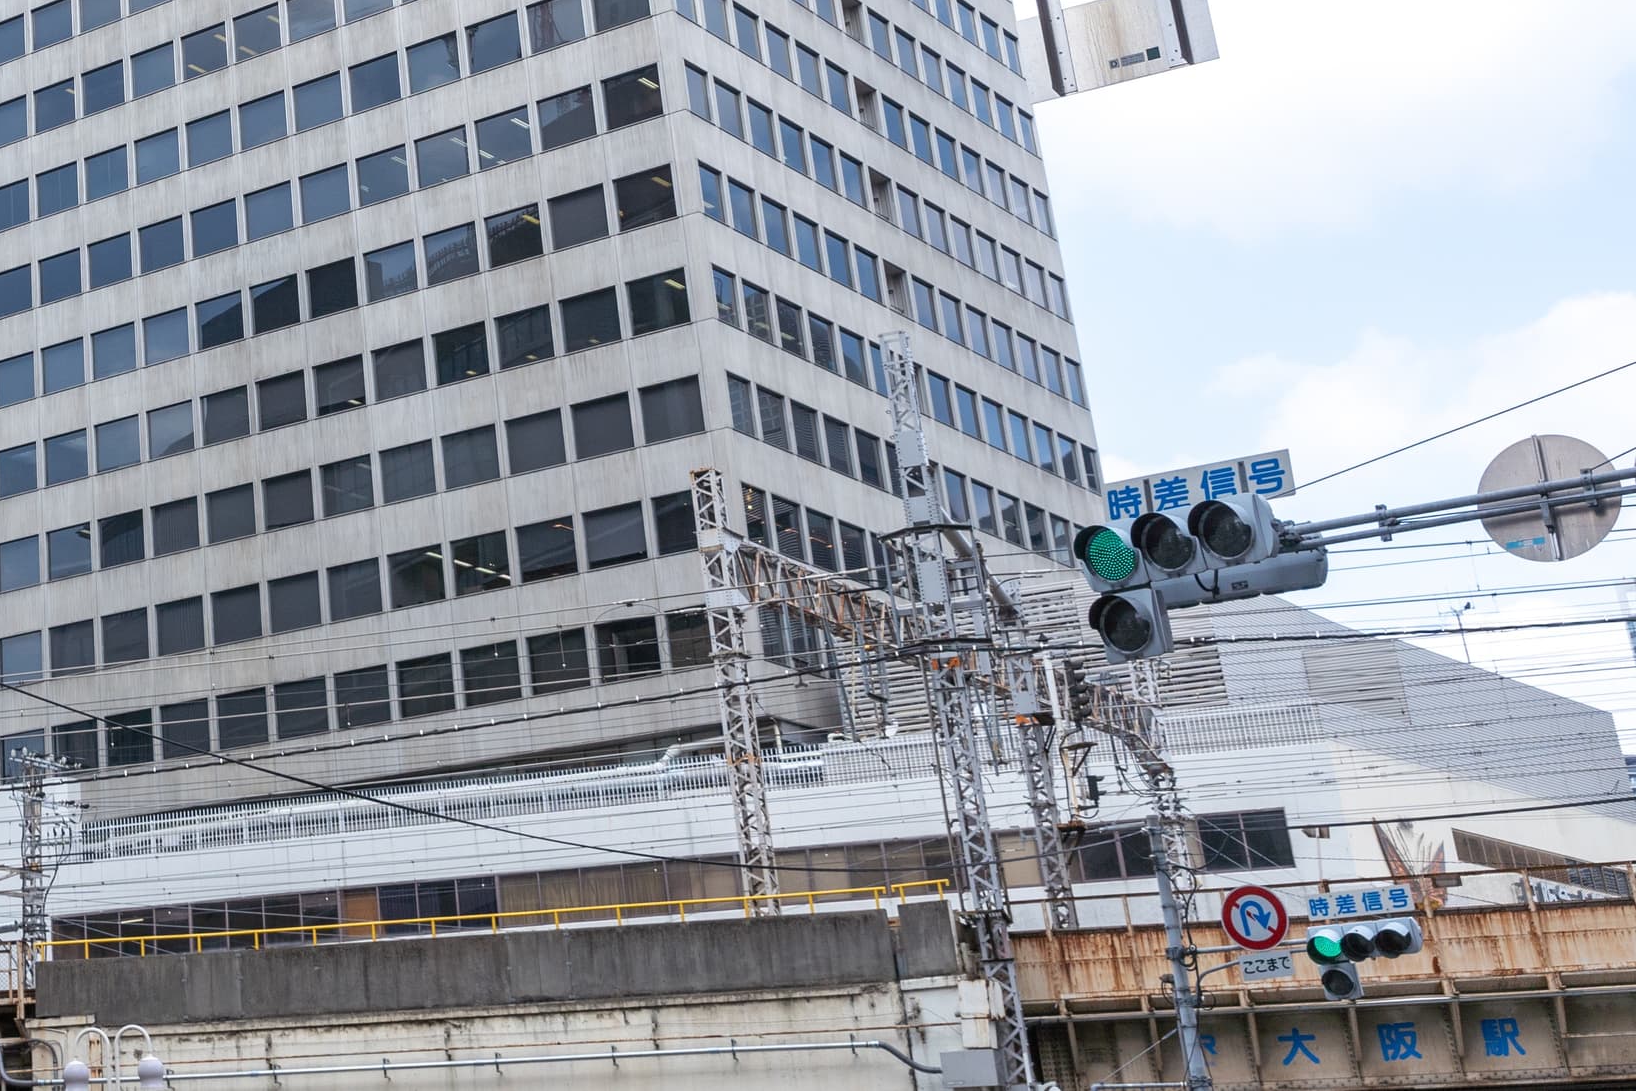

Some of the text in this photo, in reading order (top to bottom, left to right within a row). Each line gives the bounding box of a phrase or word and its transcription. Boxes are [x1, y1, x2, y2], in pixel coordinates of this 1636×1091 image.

[1107, 457, 1286, 521] 時差信号
[1308, 888, 1410, 918] 時差信号
[1243, 956, 1291, 975] ここまで
